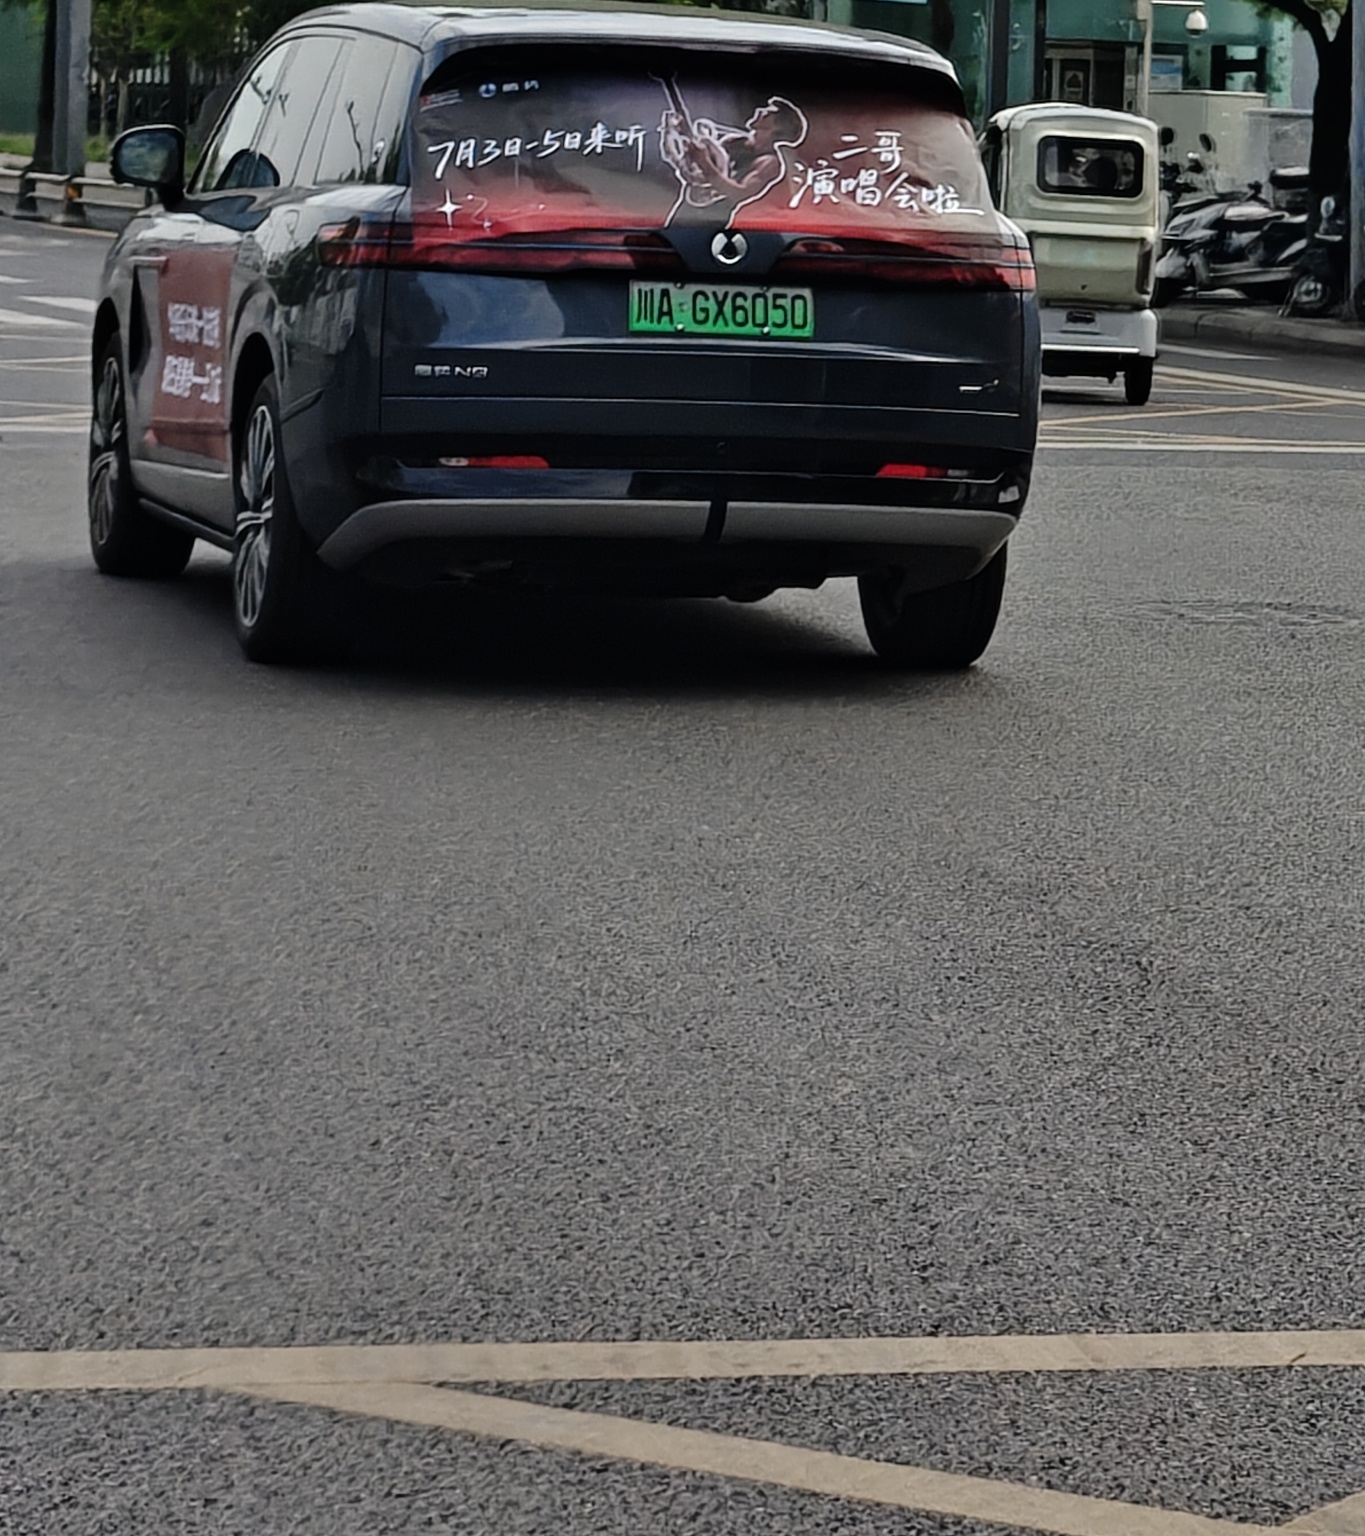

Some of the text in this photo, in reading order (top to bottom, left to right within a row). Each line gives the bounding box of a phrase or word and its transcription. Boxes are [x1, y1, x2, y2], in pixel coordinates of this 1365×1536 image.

[833, 129, 905, 175] 二哥
[789, 159, 986, 216] 演唱会啦
